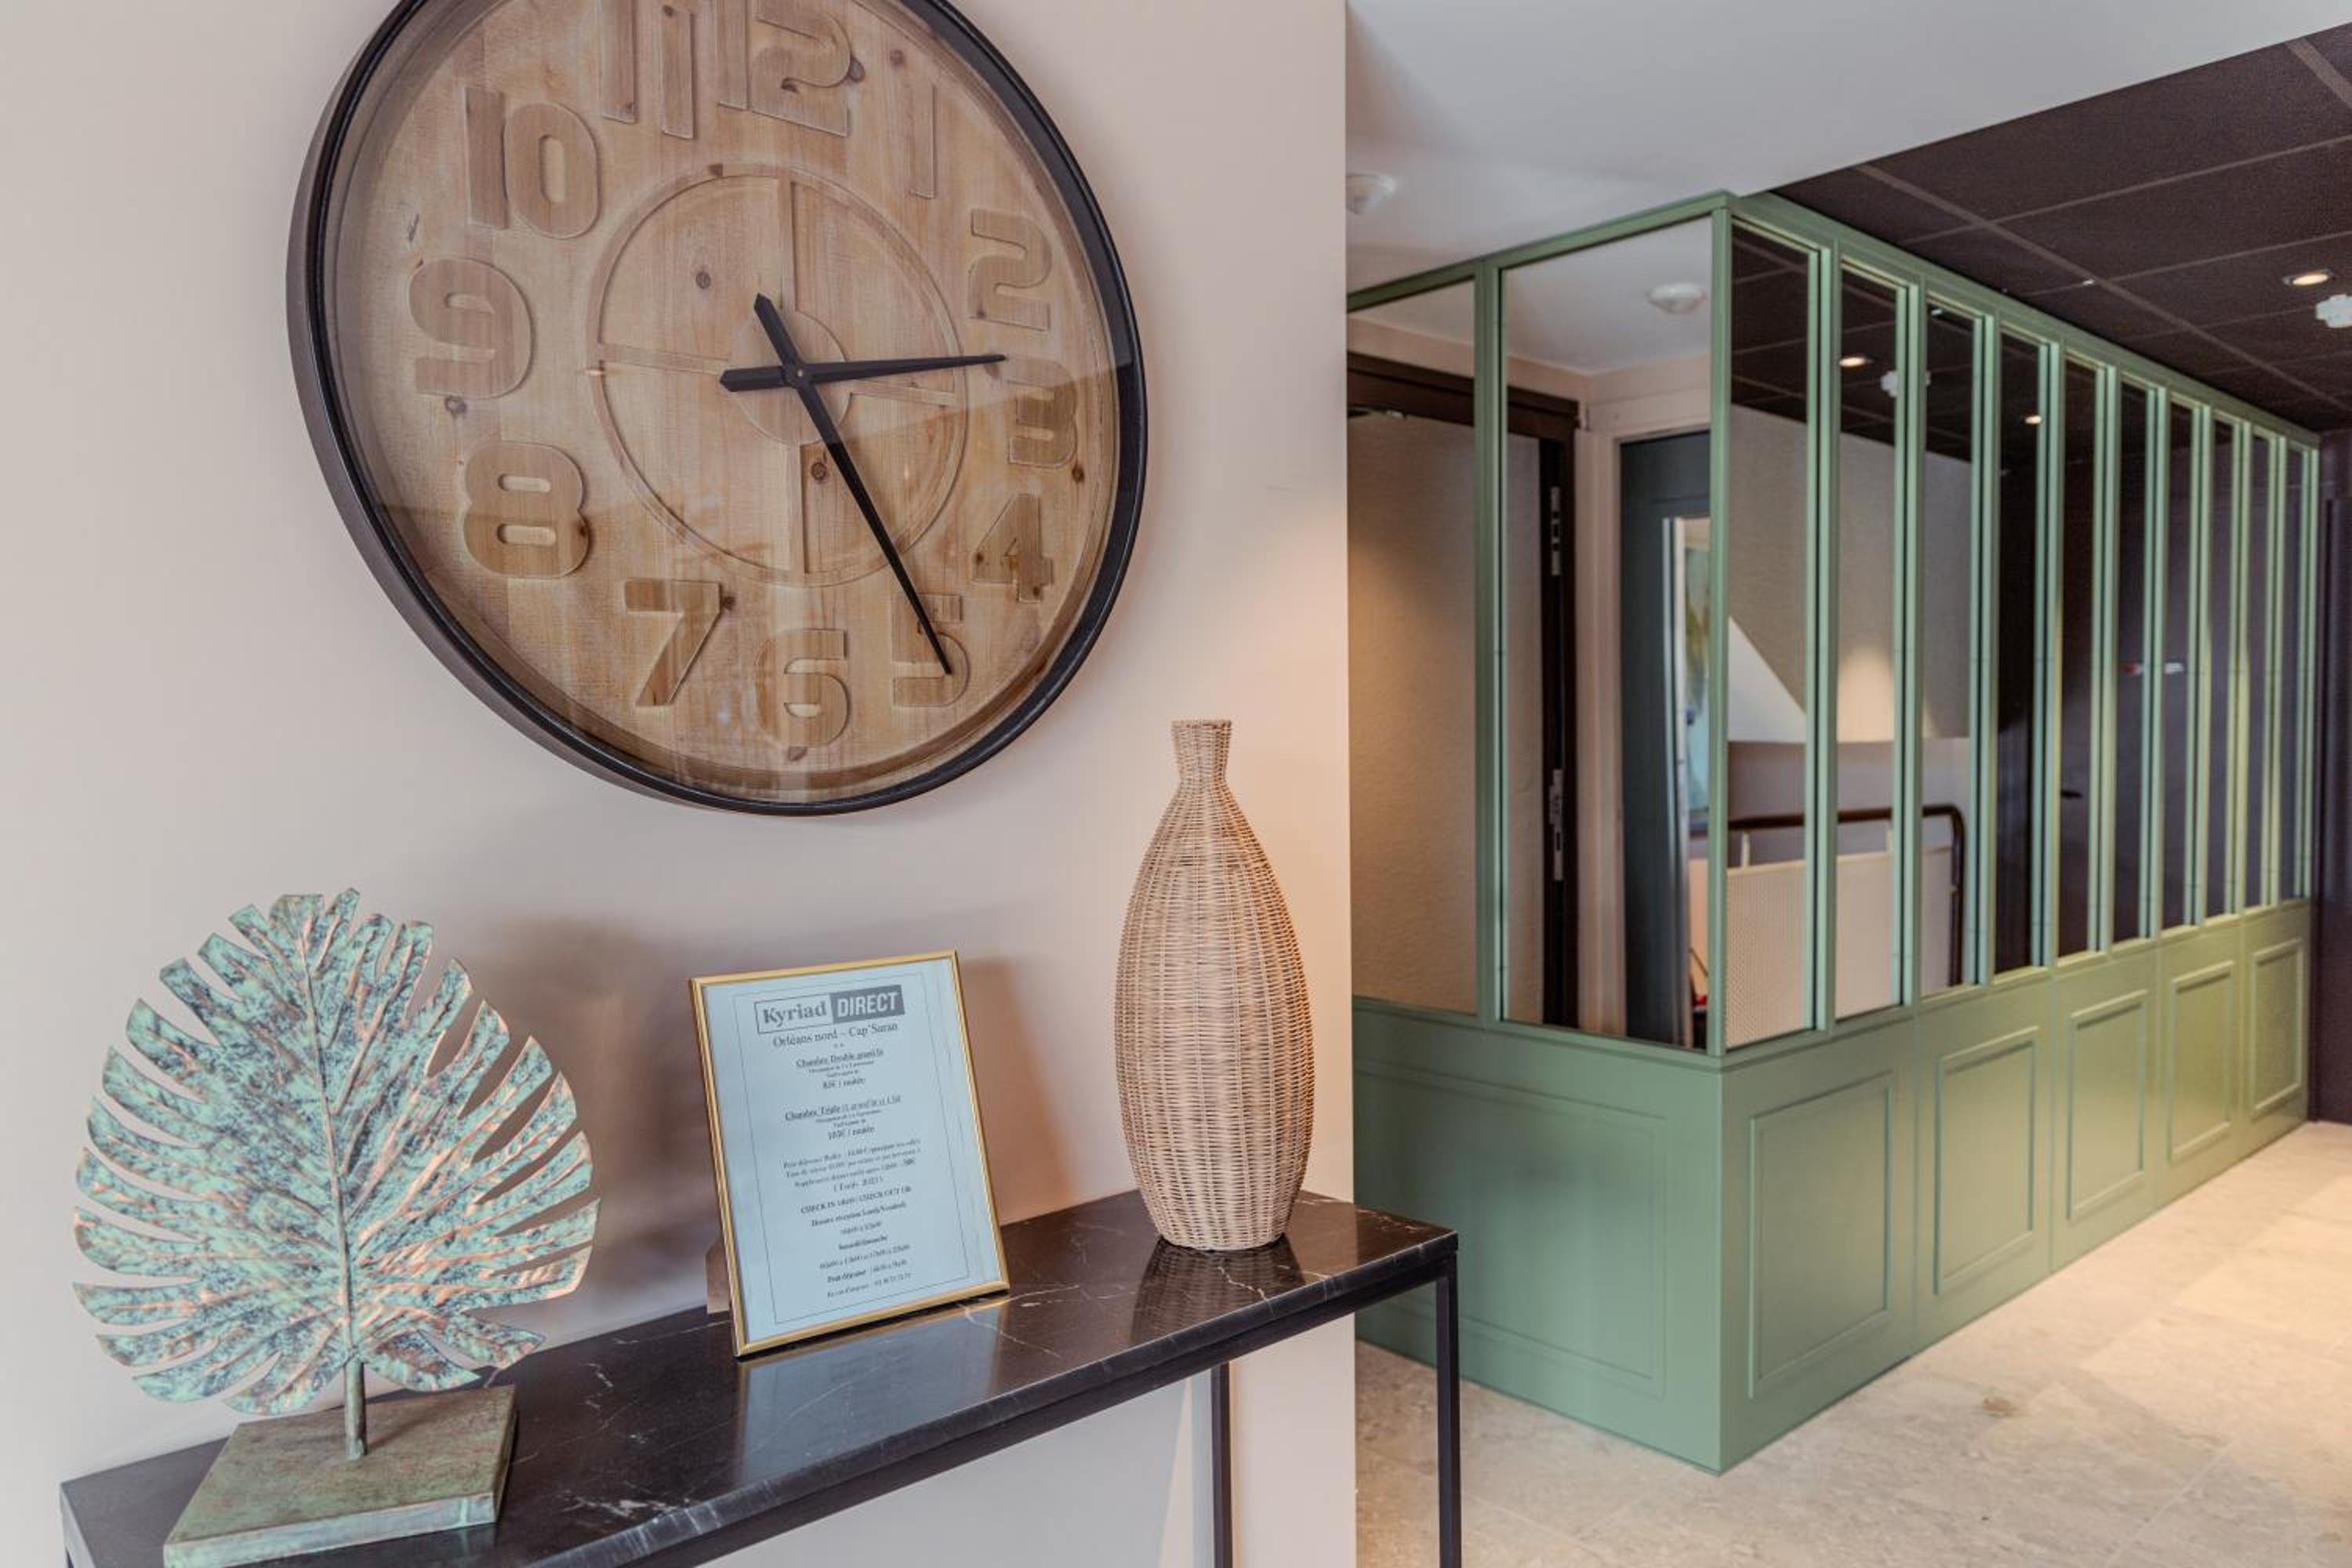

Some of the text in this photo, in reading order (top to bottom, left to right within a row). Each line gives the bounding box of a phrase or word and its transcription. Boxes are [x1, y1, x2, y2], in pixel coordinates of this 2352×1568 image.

[717, 0, 848, 138] 12
[464, 86, 601, 239] 10
[408, 257, 535, 400] 9
[968, 208, 1054, 332] 2
[1006, 358, 1081, 469] 3
[463, 441, 590, 579] 8
[970, 492, 1054, 604] 4
[625, 579, 723, 706] 7
[754, 627, 851, 748] 6
[891, 593, 970, 708] 5
[763, 992, 898, 1027] Kyriad DIRECT
